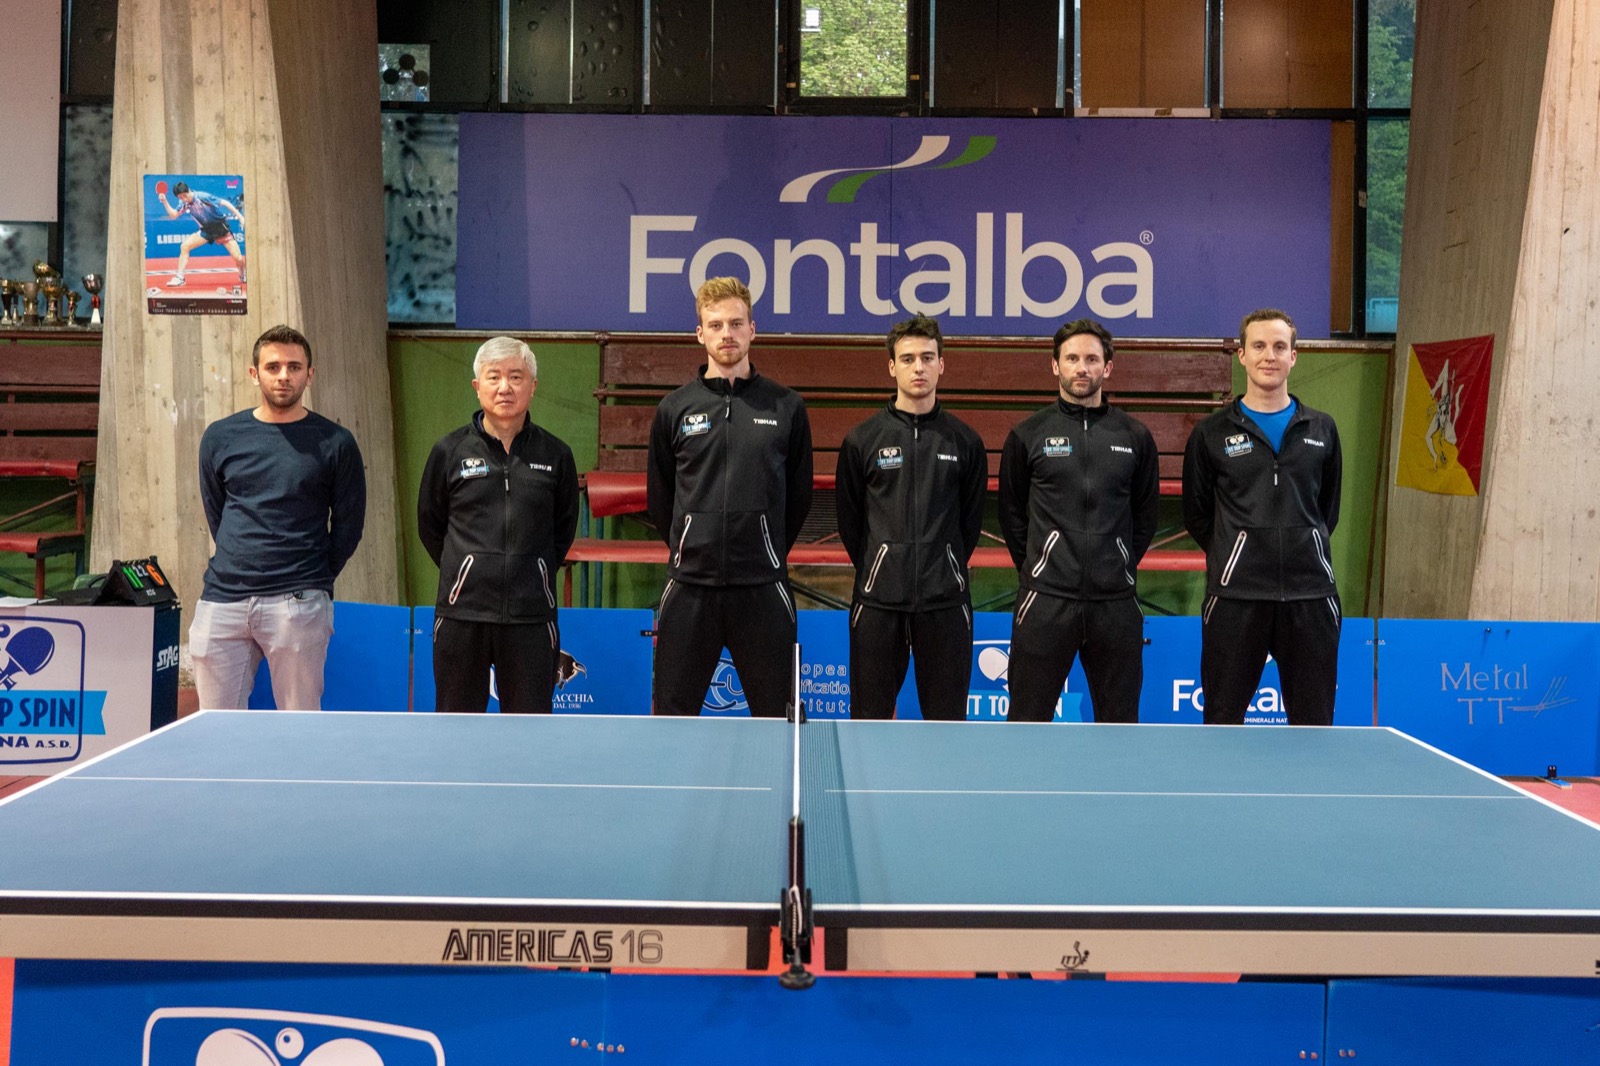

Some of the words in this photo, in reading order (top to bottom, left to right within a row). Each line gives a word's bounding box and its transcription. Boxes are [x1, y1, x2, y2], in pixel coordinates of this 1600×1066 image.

[156, 645, 179, 671] STAG
[801, 663, 847, 678] opea
[1441, 662, 1529, 691] Metal
[552, 694, 594, 703] ACCHIA
[988, 695, 1010, 716] TO
[1457, 697, 1514, 725] TT
[0, 697, 14, 727] P
[18, 697, 76, 728] SPIN
[0, 735, 30, 748] NA
[35, 739, 72, 749] A.S.D.
[442, 929, 614, 964] AMERICAS
[620, 929, 664, 964] 16
